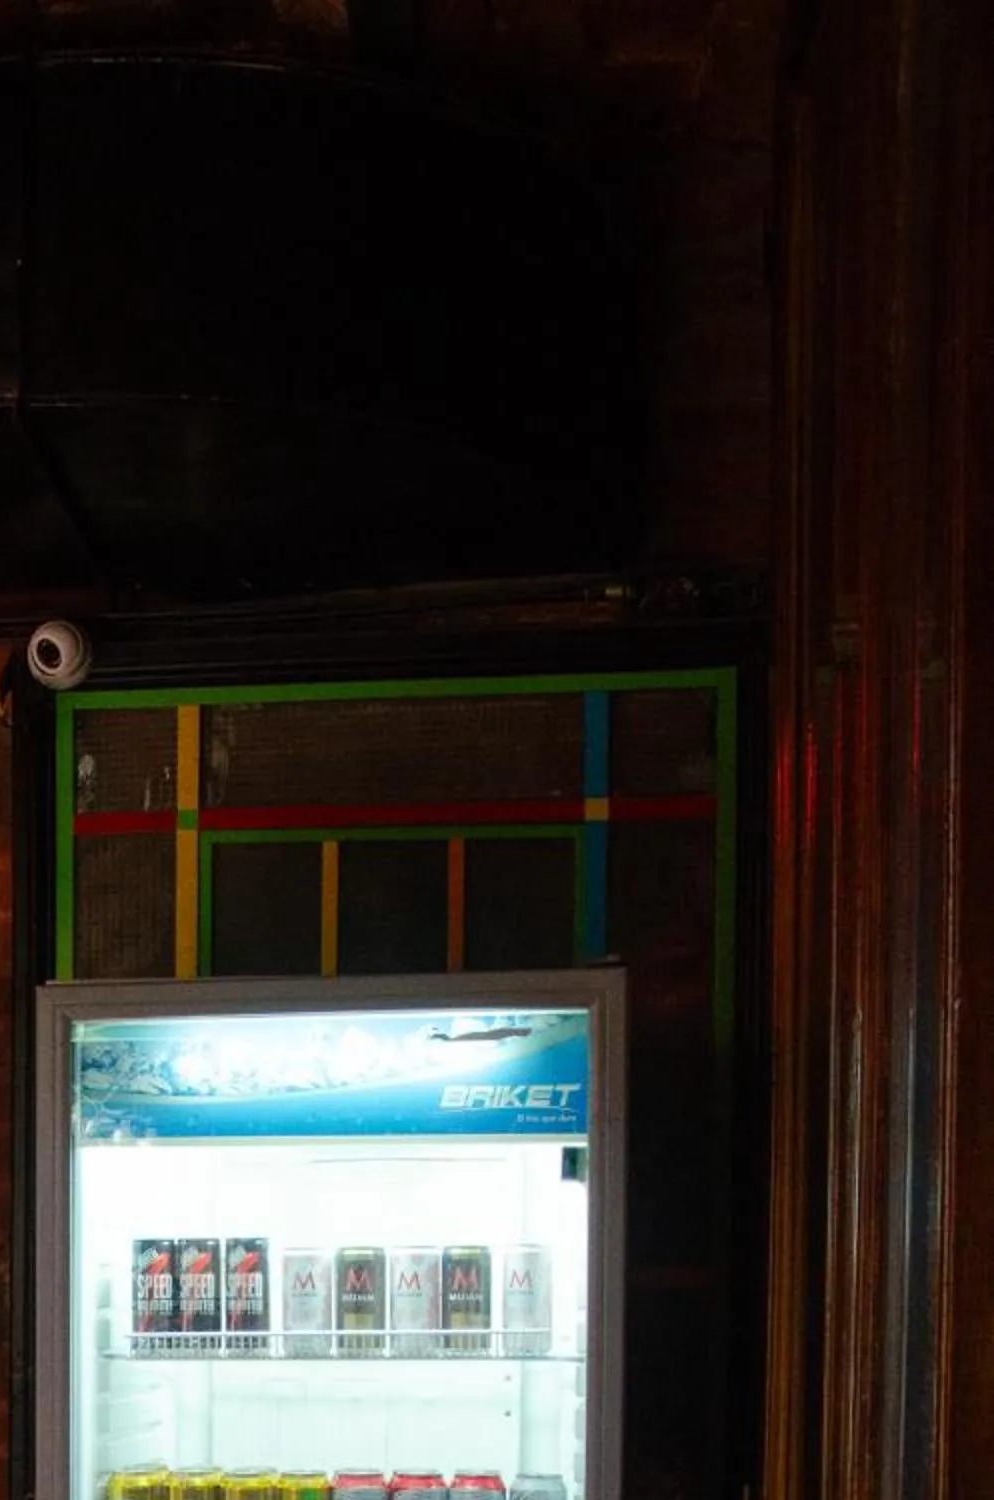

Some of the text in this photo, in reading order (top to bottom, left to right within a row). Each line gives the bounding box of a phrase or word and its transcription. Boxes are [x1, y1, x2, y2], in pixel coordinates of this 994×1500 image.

[439, 1083, 581, 1110] BRIKET
[137, 1274, 173, 1299] SPEED
[180, 1273, 215, 1299] SPEED
[228, 1272, 263, 1298] SPEED
